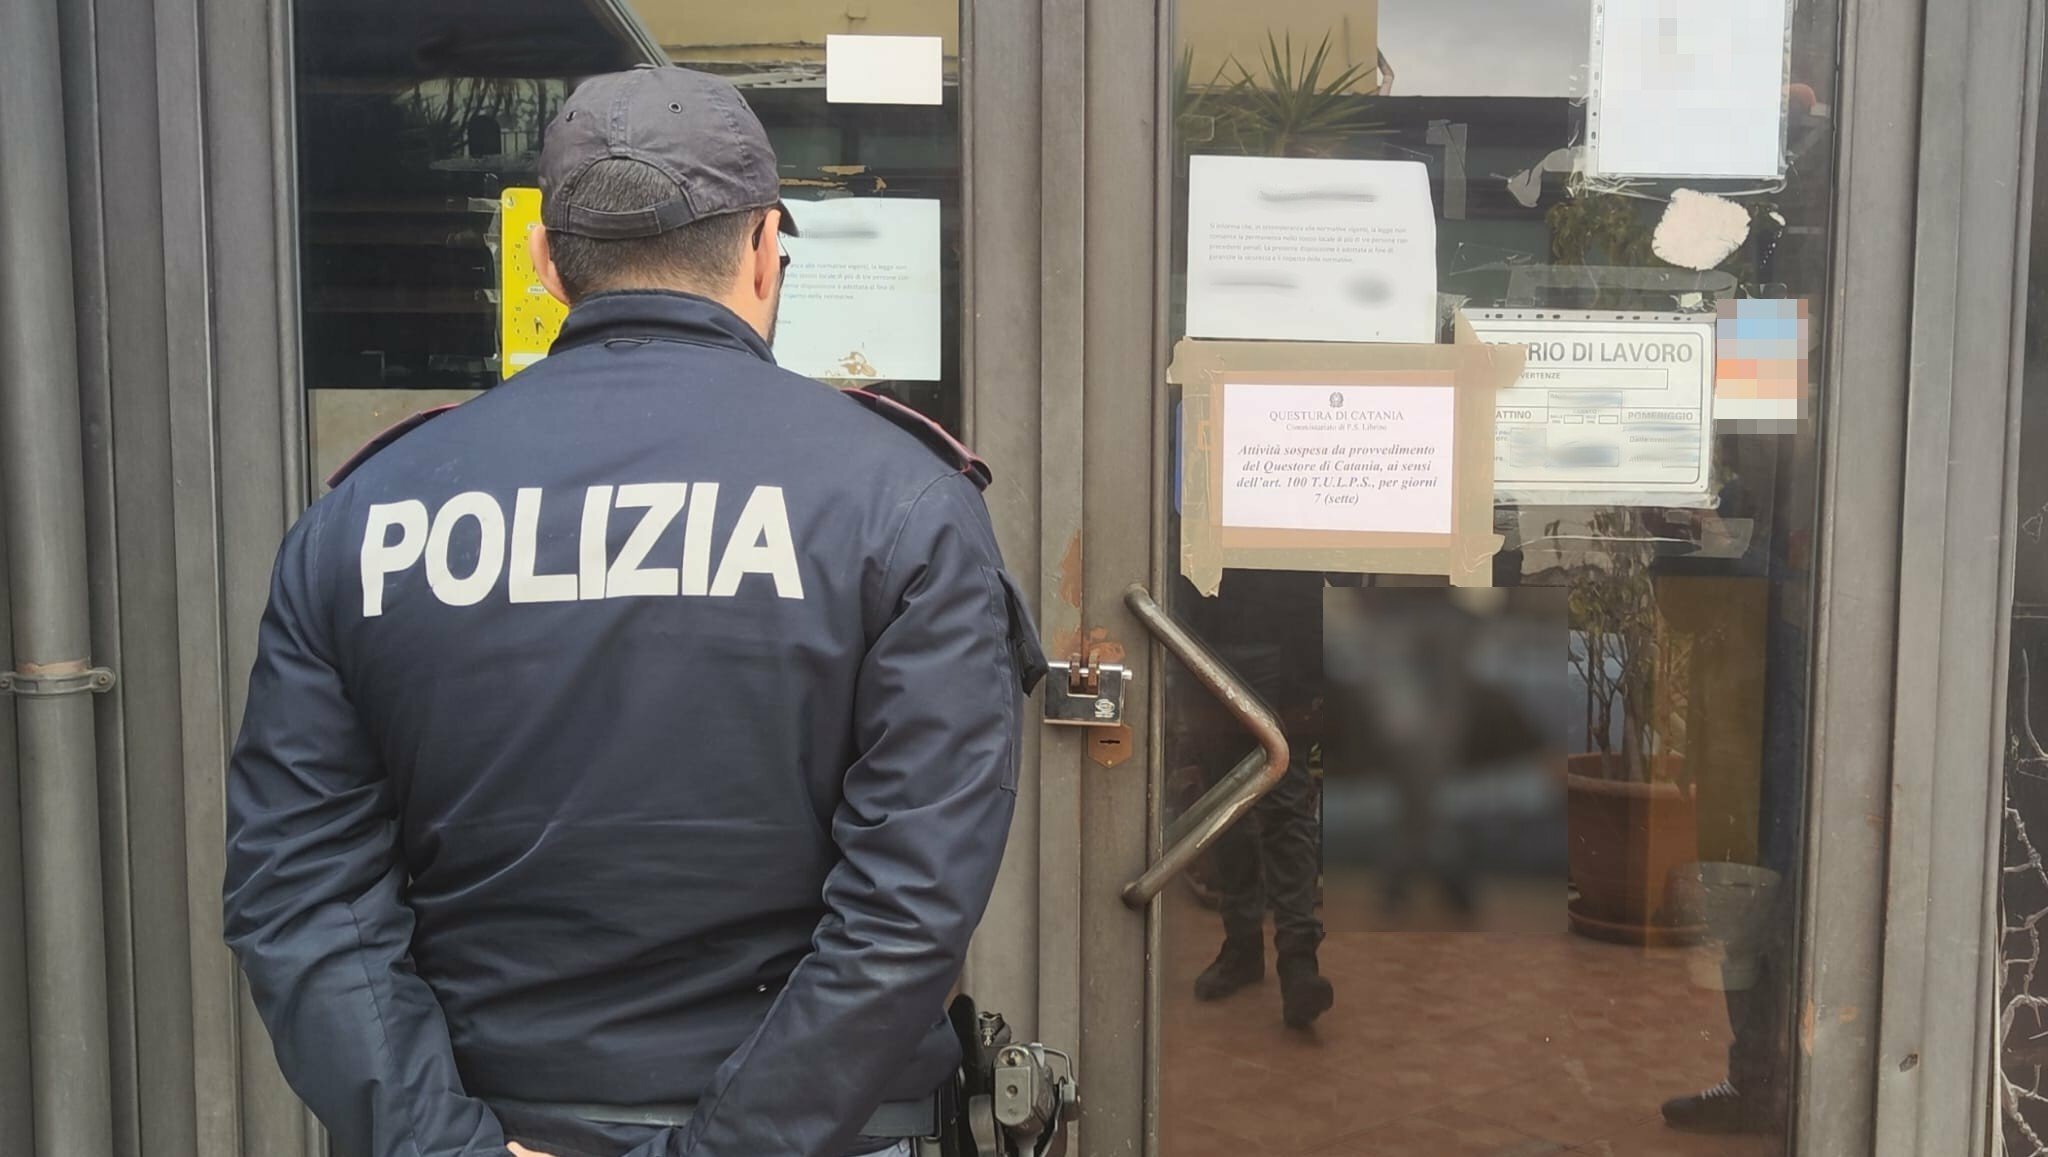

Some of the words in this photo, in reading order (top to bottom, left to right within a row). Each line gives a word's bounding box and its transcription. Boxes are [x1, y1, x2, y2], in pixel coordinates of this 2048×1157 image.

[1572, 342, 1593, 362] DI
[1600, 342, 1693, 363] LAVORO
[1521, 372, 1561, 380] VERTENZE
[1269, 411, 1332, 422] QUESTURA
[1336, 411, 1348, 421] DI
[1350, 411, 1404, 421] CATANIA
[1496, 411, 1532, 420] ATTINO
[1238, 444, 1281, 456] Attività
[1283, 447, 1328, 458] sospesa
[1331, 445, 1346, 456] da
[1348, 444, 1436, 458] provvedimento
[1242, 460, 1259, 471] del
[1263, 461, 1316, 474] Questore
[1319, 460, 1330, 471] di
[1334, 461, 1383, 473] Catania,
[1386, 461, 1399, 472] ai
[1401, 461, 1432, 472] sensi
[1287, 477, 1308, 488] 100
[1378, 480, 1398, 490] per
[1400, 477, 1438, 490] giorni
[1314, 493, 1322, 504] 7
[1324, 493, 1359, 505] (sette)
[361, 482, 805, 617] POLIZIA
